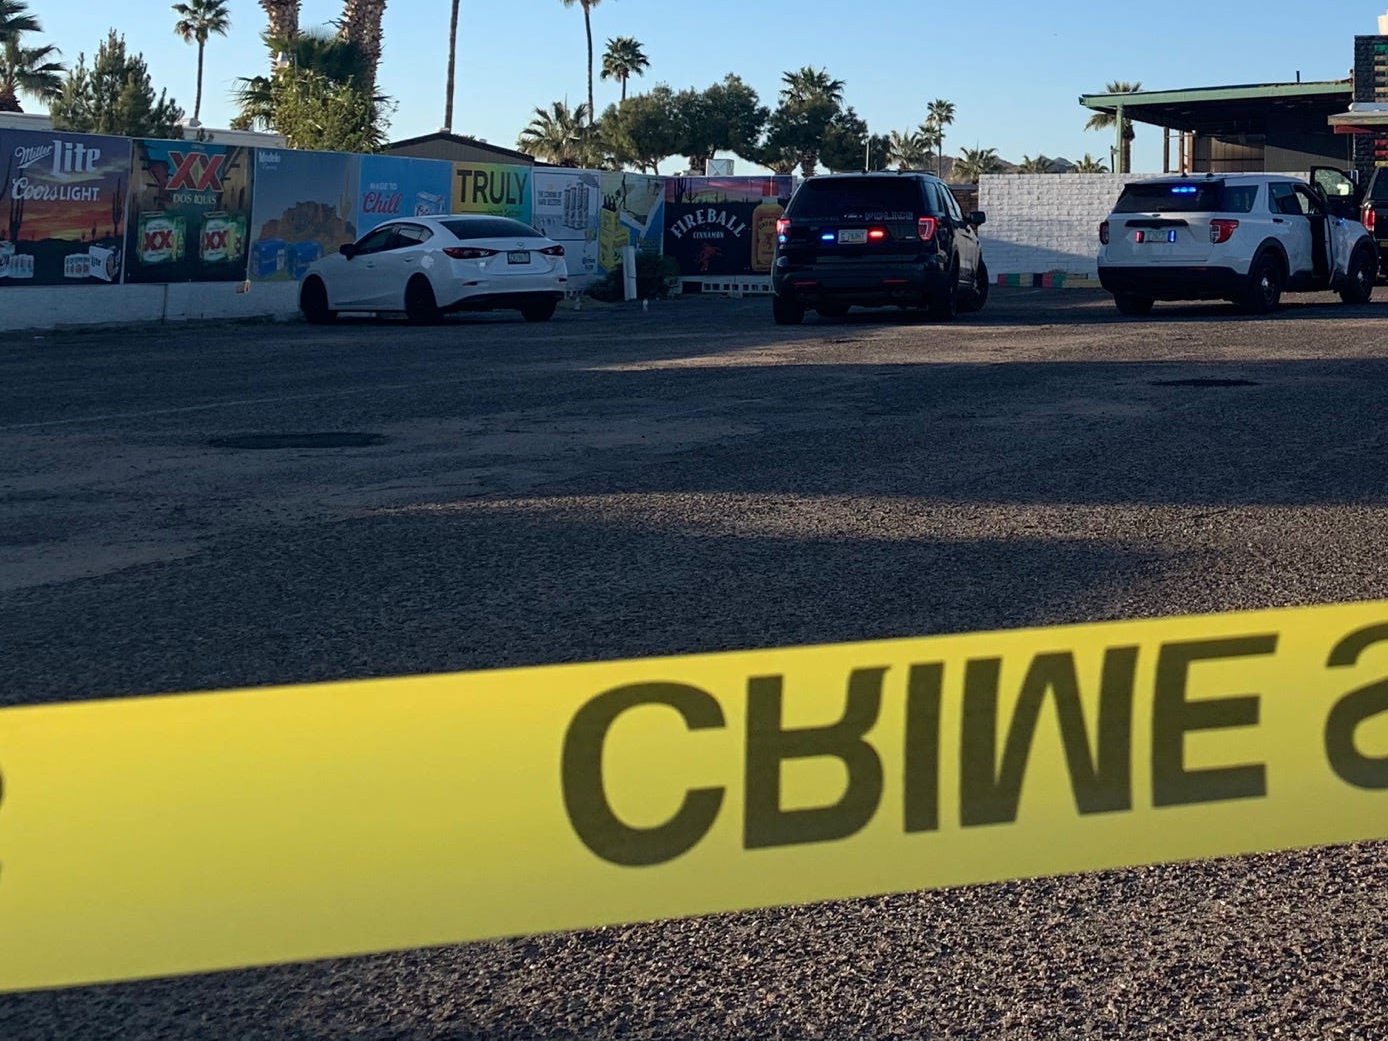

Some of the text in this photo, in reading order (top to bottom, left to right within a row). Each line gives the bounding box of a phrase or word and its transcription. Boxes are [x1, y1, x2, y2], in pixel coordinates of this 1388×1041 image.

[14, 145, 53, 169] Miller
[165, 151, 226, 192] XX
[11, 177, 100, 201] Coors LIGHT
[370, 182, 398, 190] MADE TO
[456, 169, 528, 205] TRULY
[172, 193, 192, 204] DOS
[363, 191, 404, 214] Chill
[670, 209, 747, 239] FIREBALL
[693, 231, 724, 239] CINNAMON
